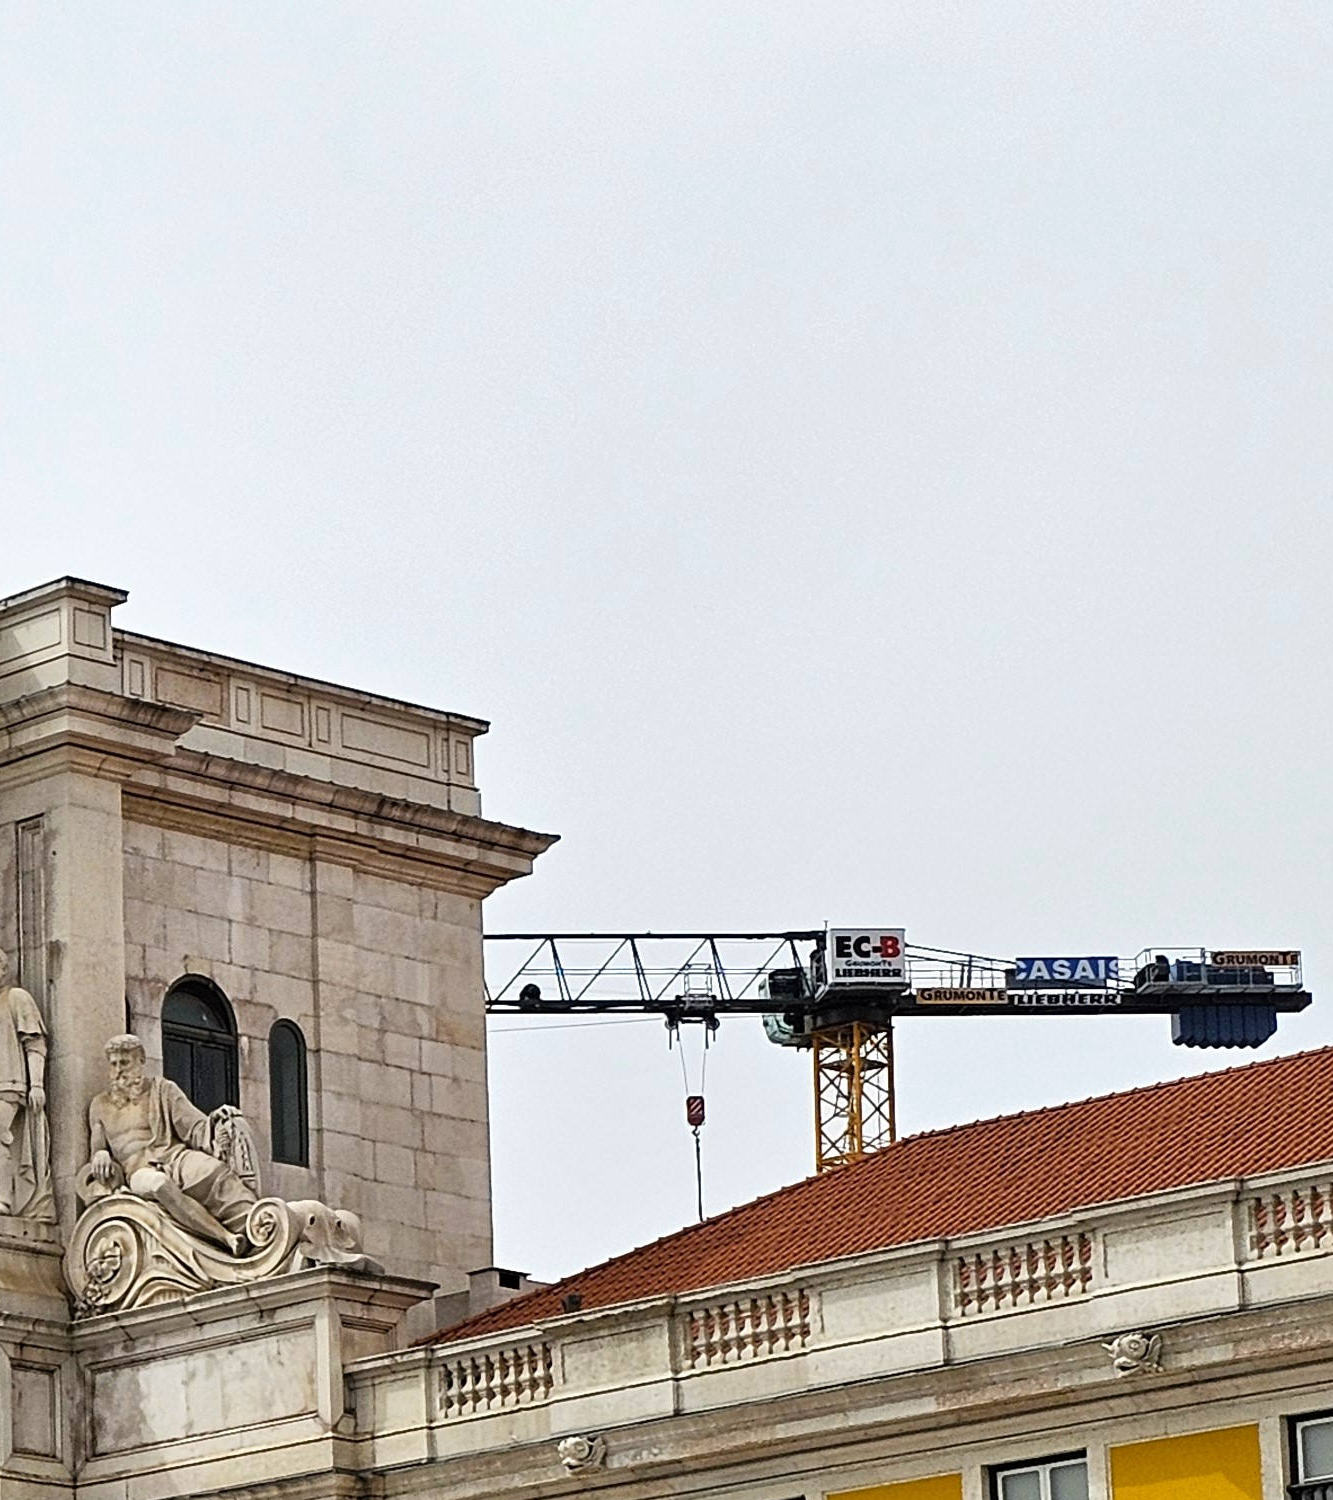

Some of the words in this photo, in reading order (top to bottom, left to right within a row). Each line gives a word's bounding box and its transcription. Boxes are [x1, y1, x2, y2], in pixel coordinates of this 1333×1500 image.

[835, 935, 901, 958] EC-B
[1212, 951, 1300, 966] GRUMONTE
[835, 968, 903, 978] LIEBHERR
[920, 988, 1006, 1002] GRUMONTE
[1015, 993, 1120, 1006] LIEBHERR
